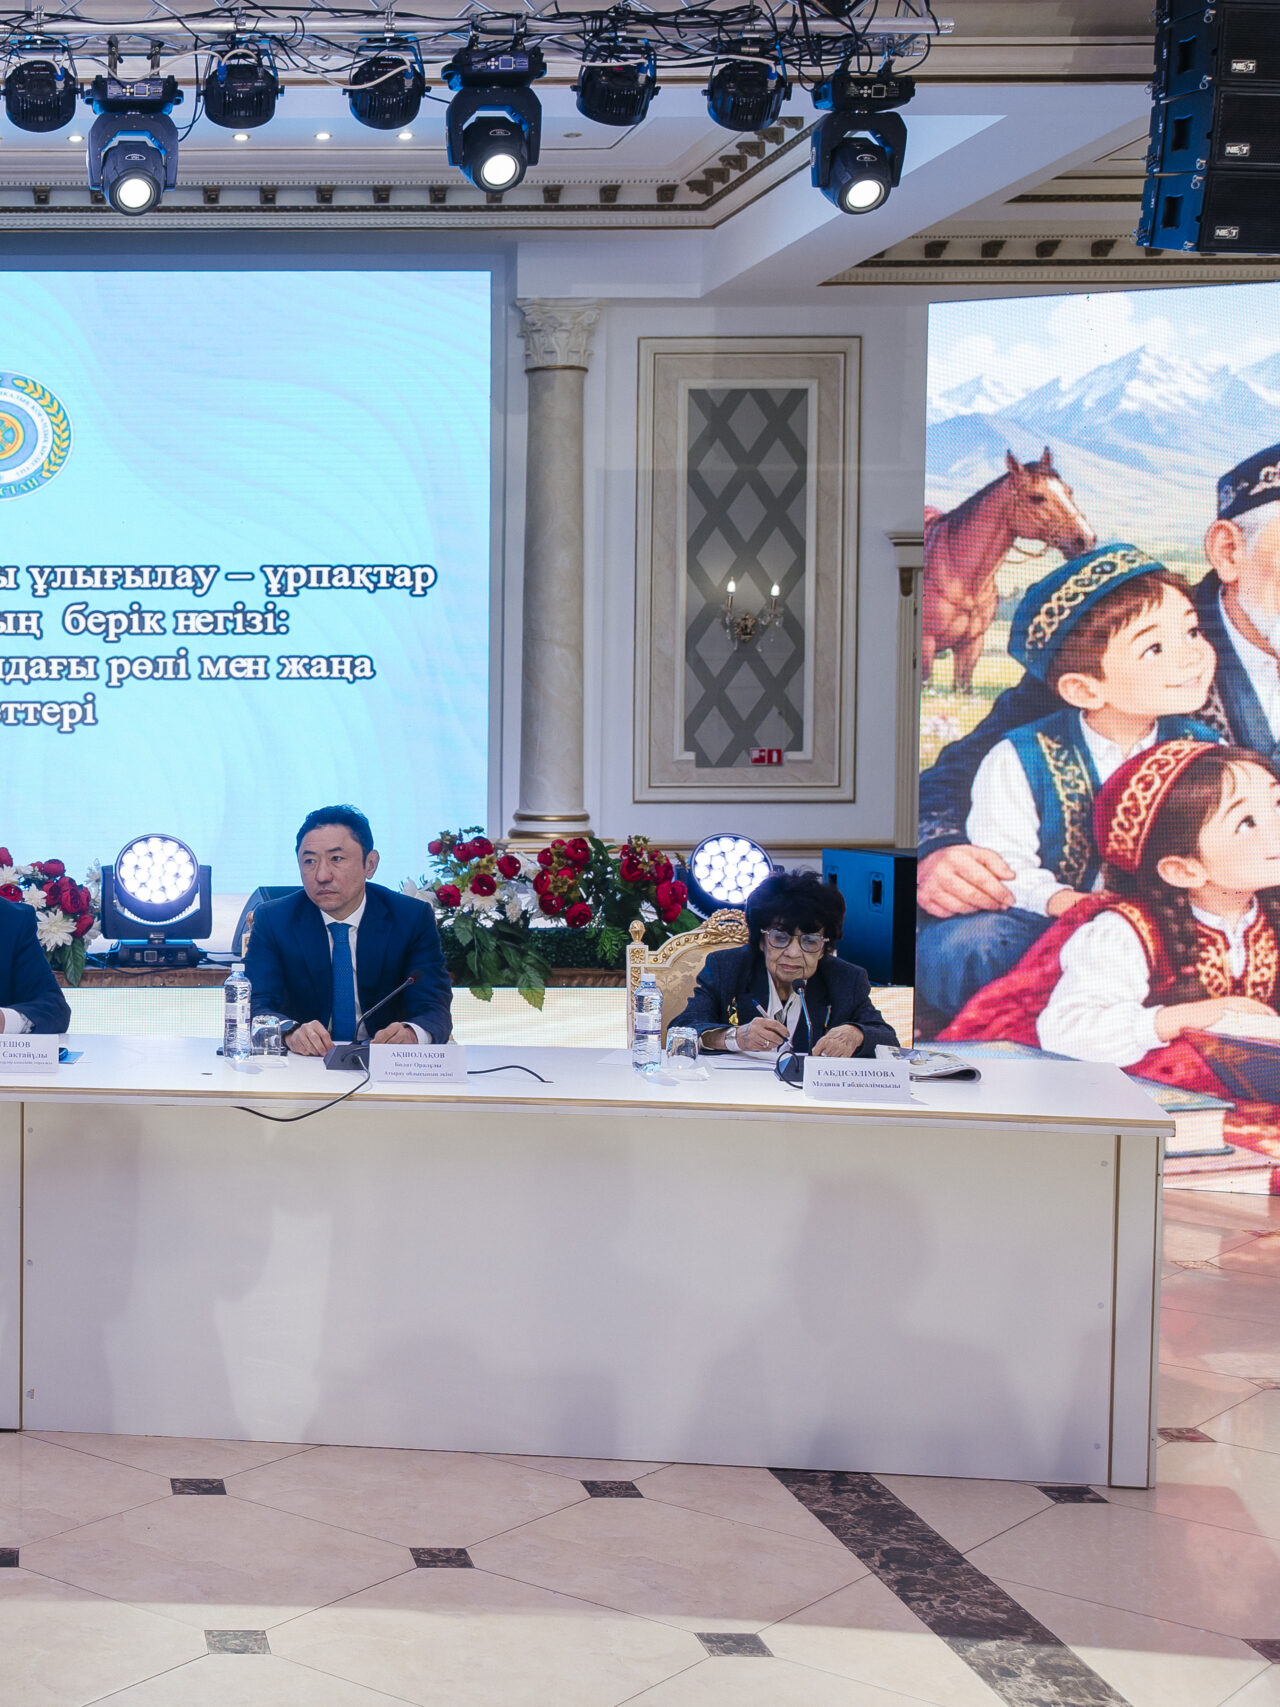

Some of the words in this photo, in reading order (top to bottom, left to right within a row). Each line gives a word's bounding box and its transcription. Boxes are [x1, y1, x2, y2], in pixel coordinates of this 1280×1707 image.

[26, 565, 220, 598] ұлығылау
[260, 565, 437, 597] ұрпақтар
[62, 601, 167, 643] берік
[172, 601, 290, 635] негізі:
[106, 647, 191, 688] рөлі
[198, 655, 270, 681] мен
[276, 655, 376, 684] жаңа
